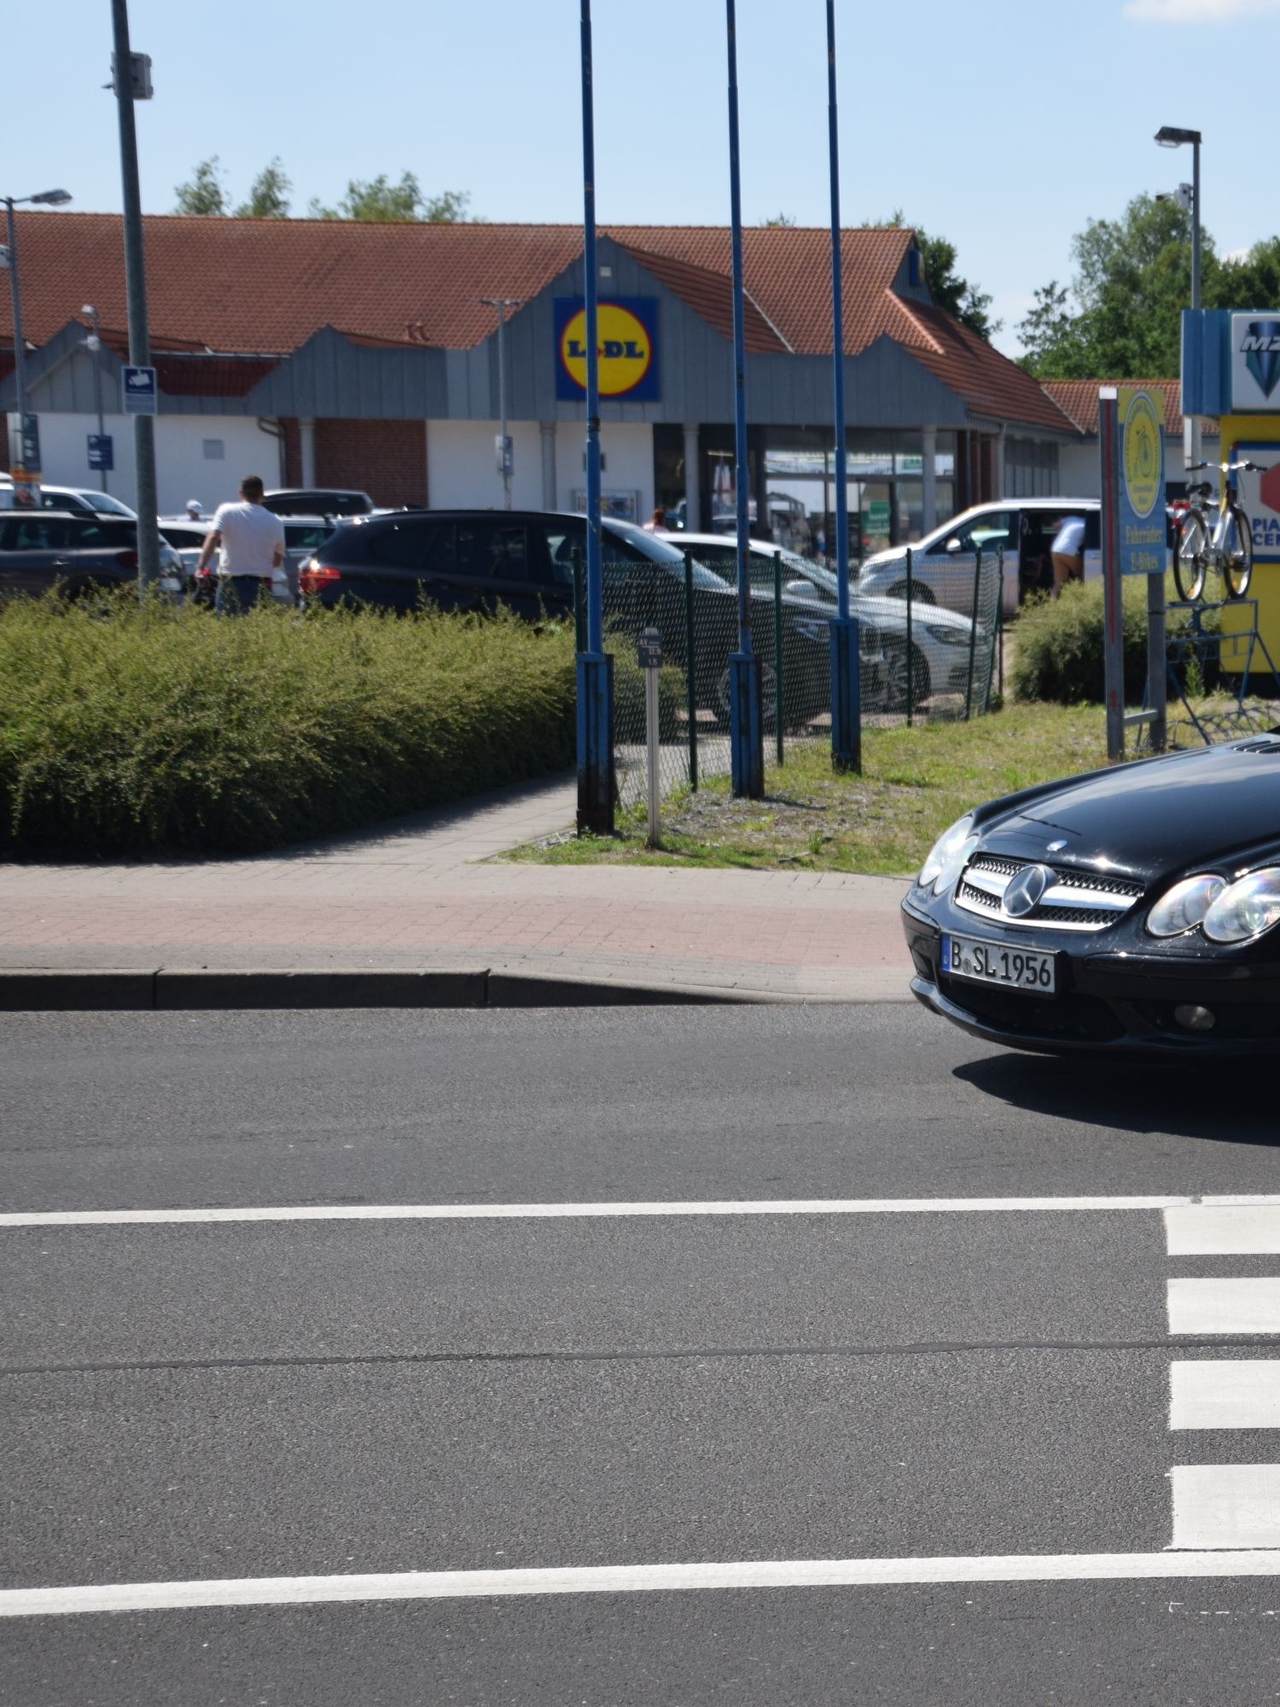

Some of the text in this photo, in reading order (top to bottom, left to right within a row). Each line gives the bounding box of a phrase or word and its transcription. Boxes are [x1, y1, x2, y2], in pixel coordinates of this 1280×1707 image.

[952, 941, 1052, 987] B SL 1956
